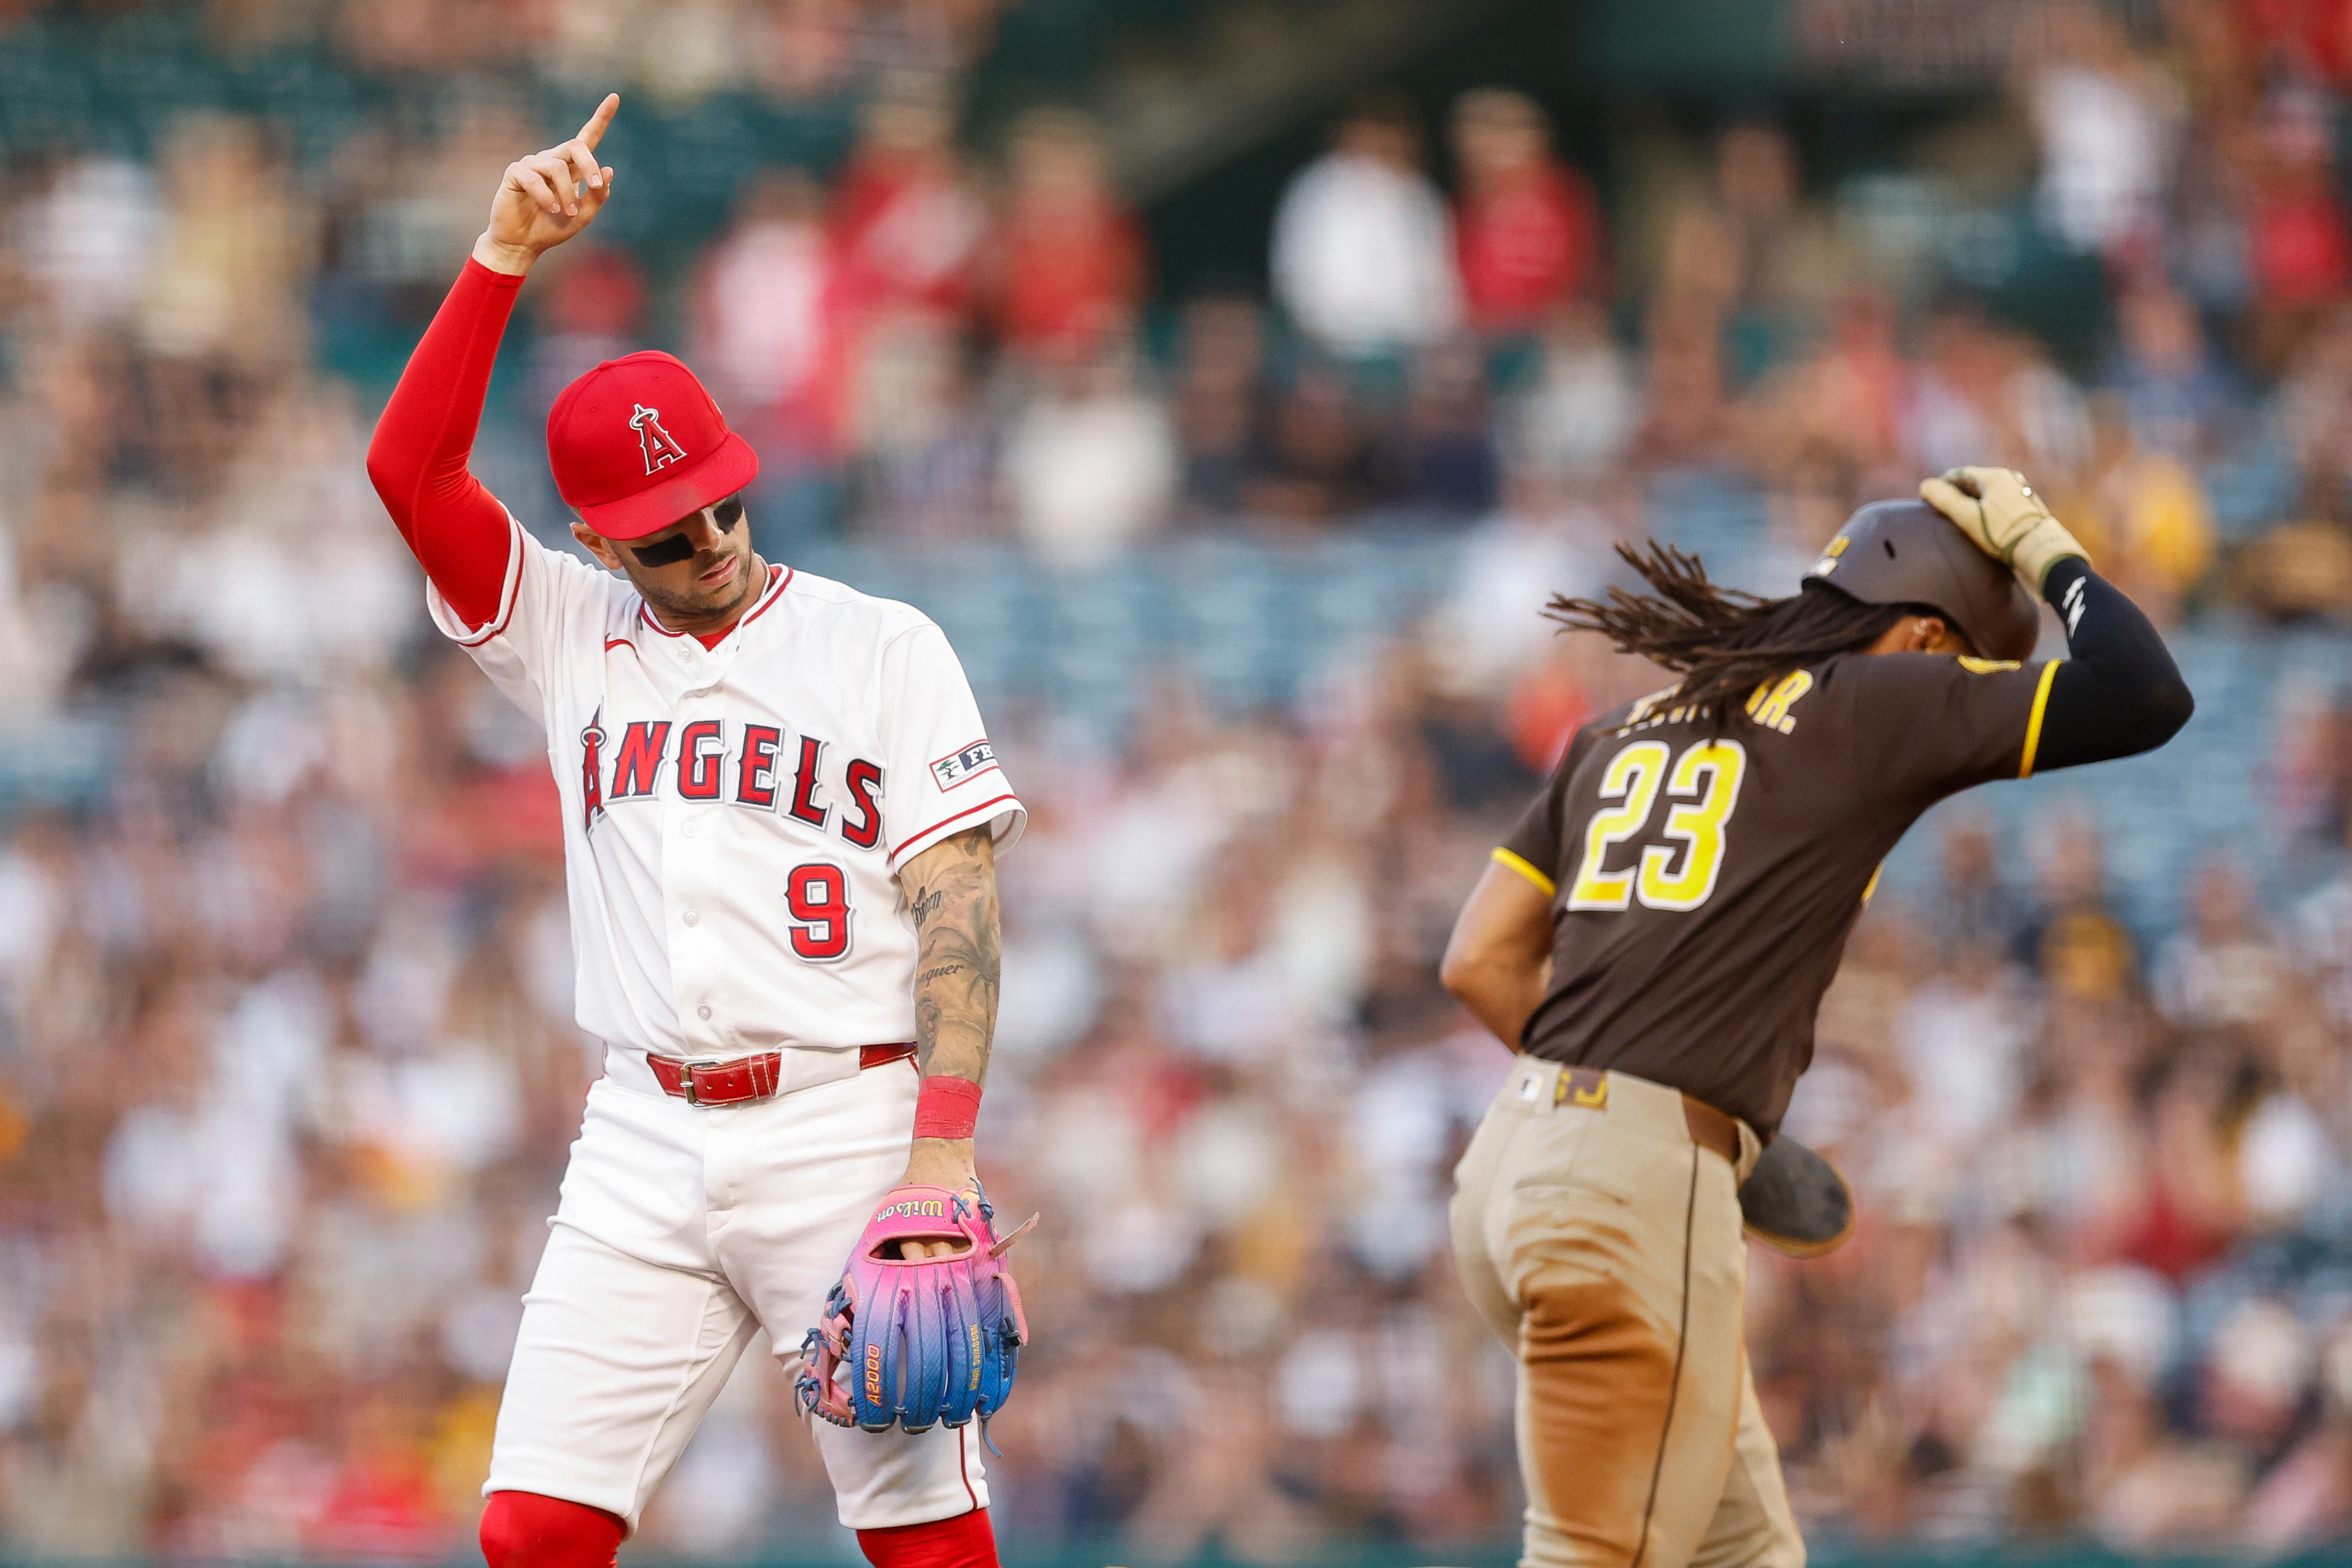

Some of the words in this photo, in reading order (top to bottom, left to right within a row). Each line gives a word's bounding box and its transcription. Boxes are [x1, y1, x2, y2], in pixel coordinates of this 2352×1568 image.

[629, 404, 687, 476] A
[580, 699, 884, 851] ANGELS
[942, 770, 973, 788] Foundation
[966, 744, 996, 766] FB
[1567, 737, 1746, 911] 23
[785, 863, 854, 963] 9
[918, 965, 966, 988] nquer
[876, 1199, 944, 1223] Wilson
[865, 1343, 882, 1408] A2000
